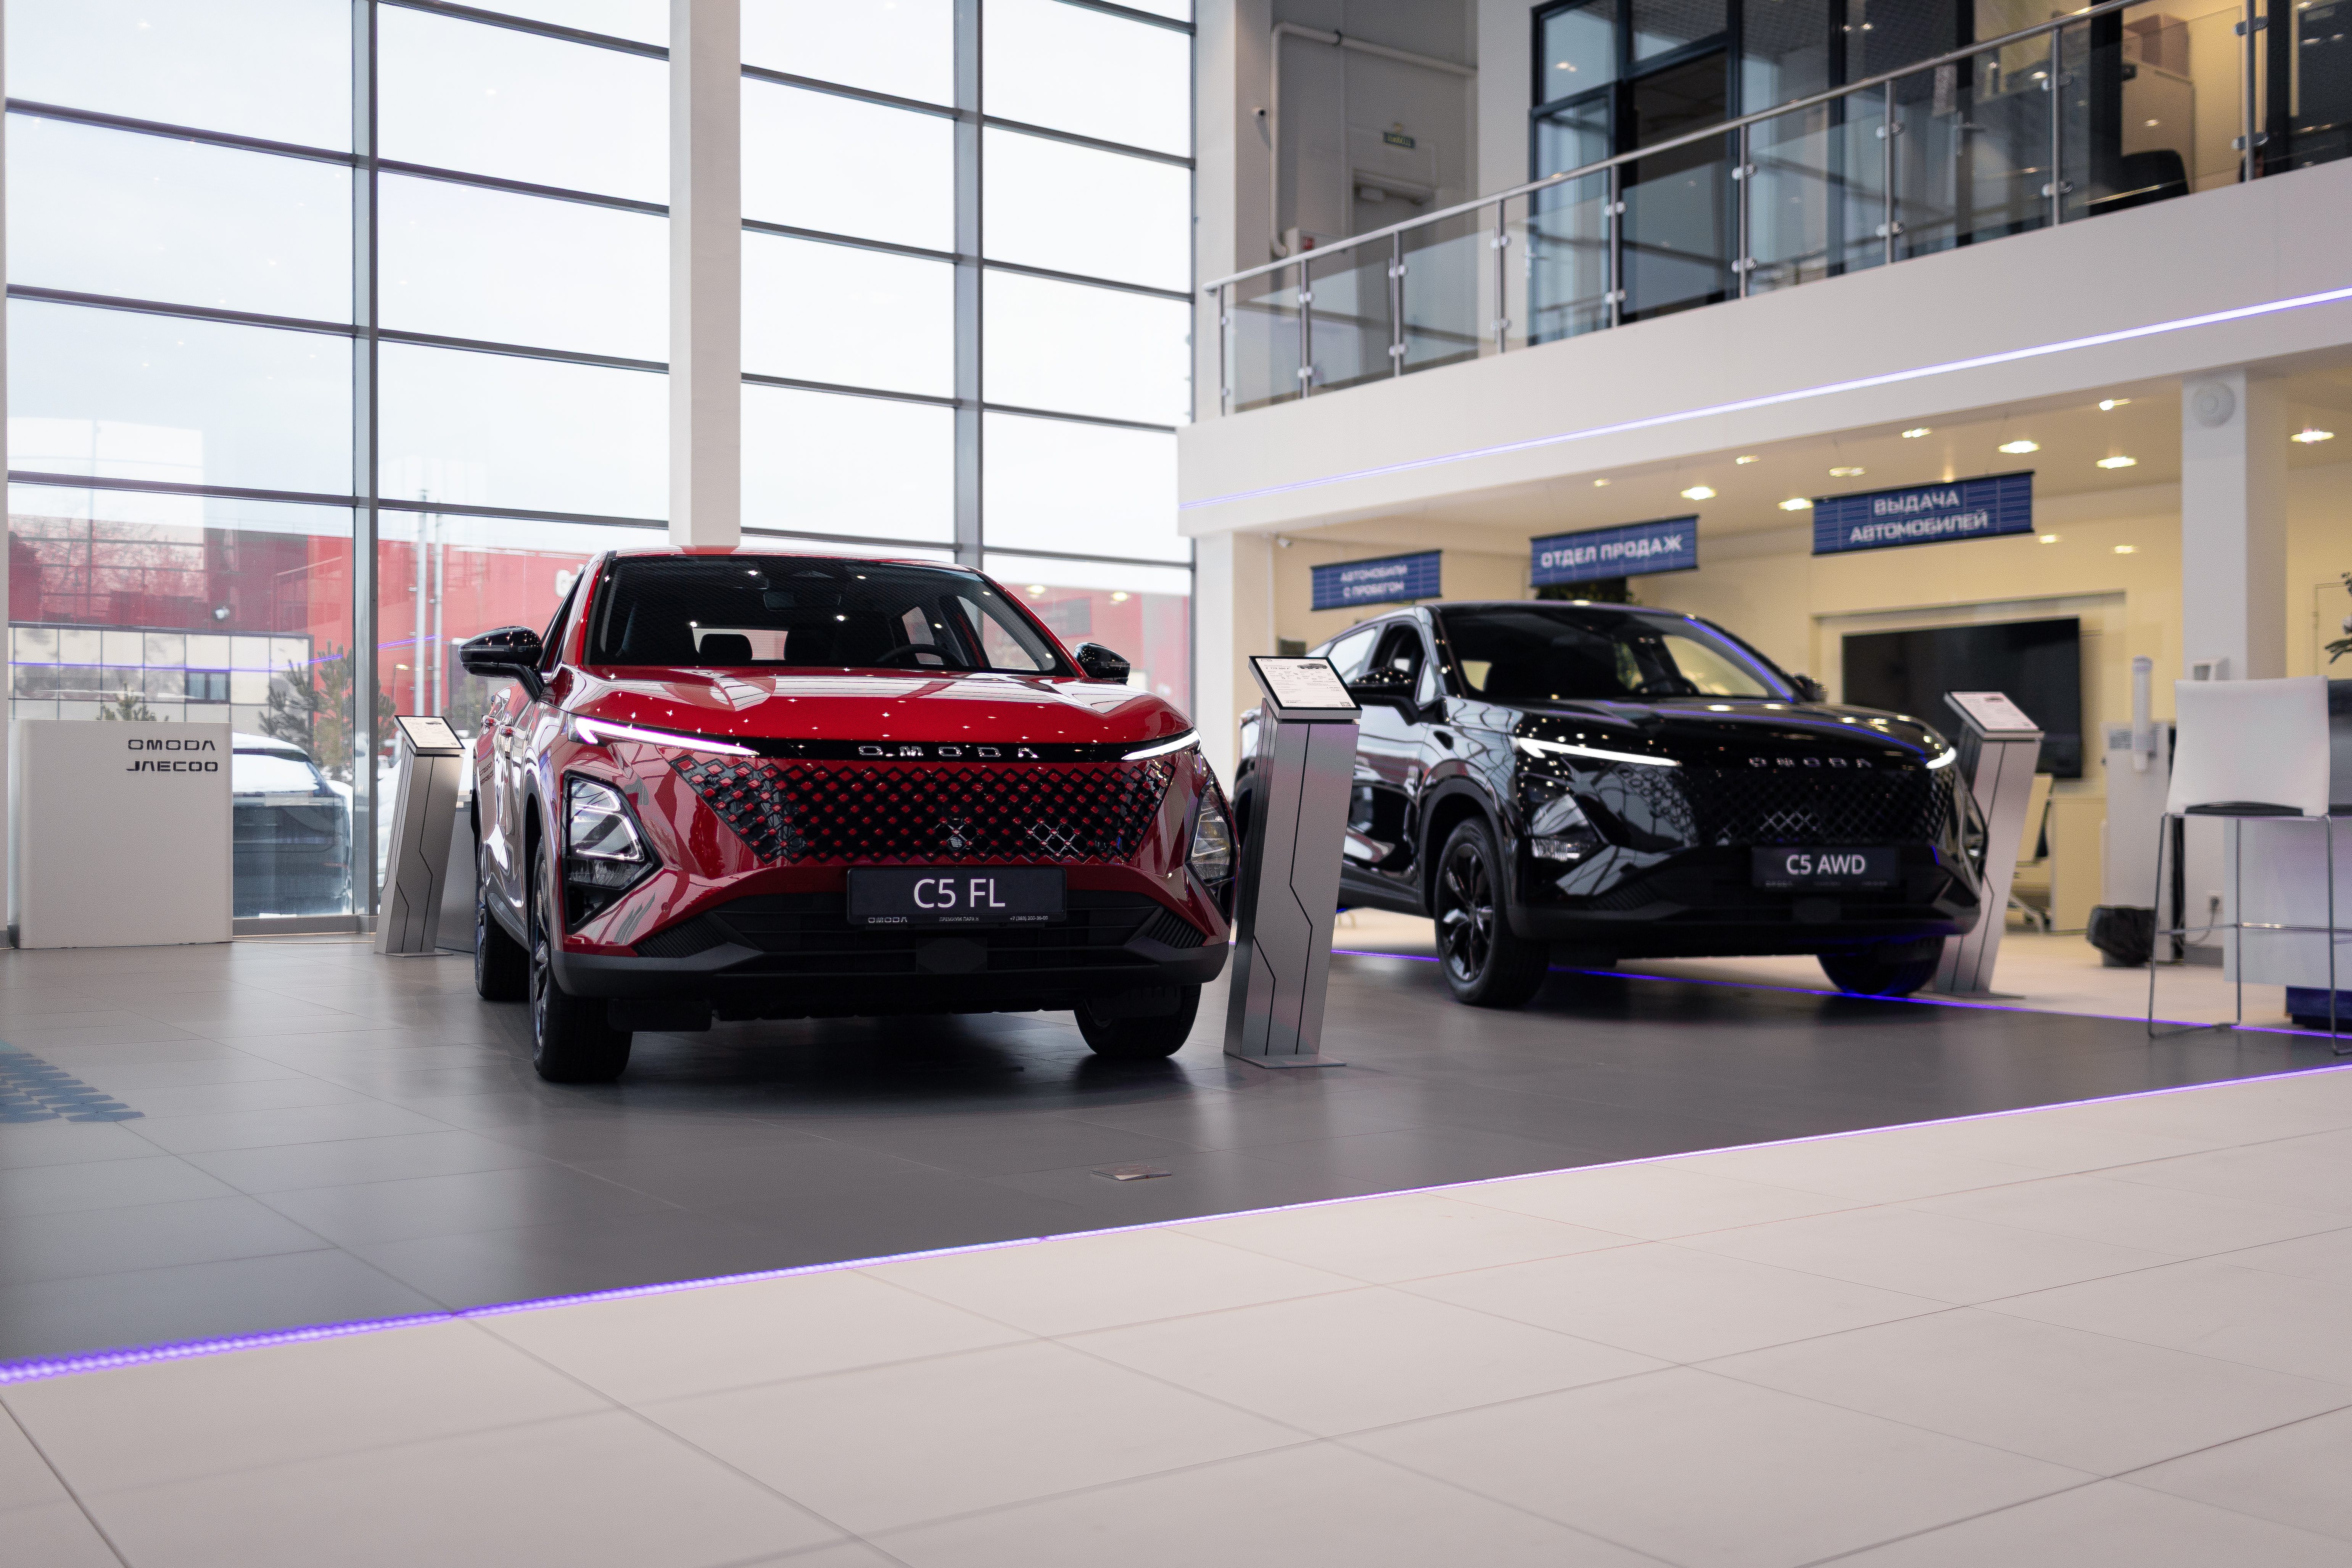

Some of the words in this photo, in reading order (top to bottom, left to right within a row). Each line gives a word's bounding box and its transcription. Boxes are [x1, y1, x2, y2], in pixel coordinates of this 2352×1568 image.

[1874, 490, 1960, 516] ВЫДАЧА
[1850, 509, 1988, 544] АВТОМОБИЛЕЙ
[1541, 546, 1596, 568] ОТДЕЛ
[1601, 535, 1682, 561] ПРОДАЖ
[128, 739, 216, 751] OMODA
[858, 746, 1038, 758] OMODA
[126, 761, 218, 772] JAECOO
[1749, 757, 1872, 768] OMODA
[1786, 855, 1811, 874] C5
[1817, 854, 1866, 874] AWD
[914, 879, 956, 908] C5
[970, 879, 1005, 907] FL
